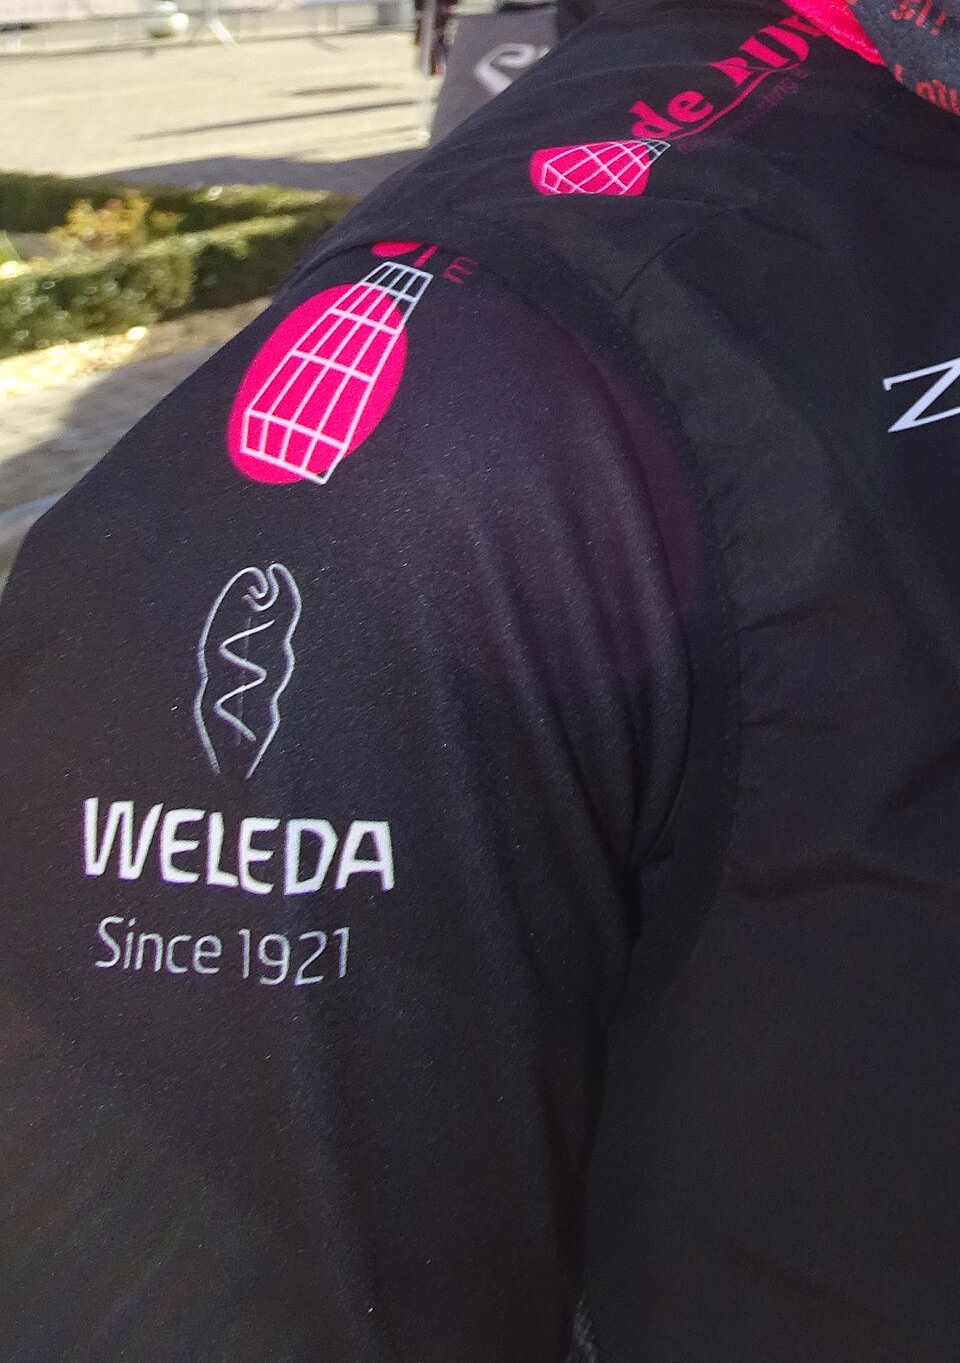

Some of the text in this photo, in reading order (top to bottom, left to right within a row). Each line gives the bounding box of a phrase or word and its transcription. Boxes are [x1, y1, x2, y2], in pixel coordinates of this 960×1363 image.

[628, 90, 715, 139] de
[83, 796, 396, 896] WELEDA
[94, 914, 351, 986] Since 1921
